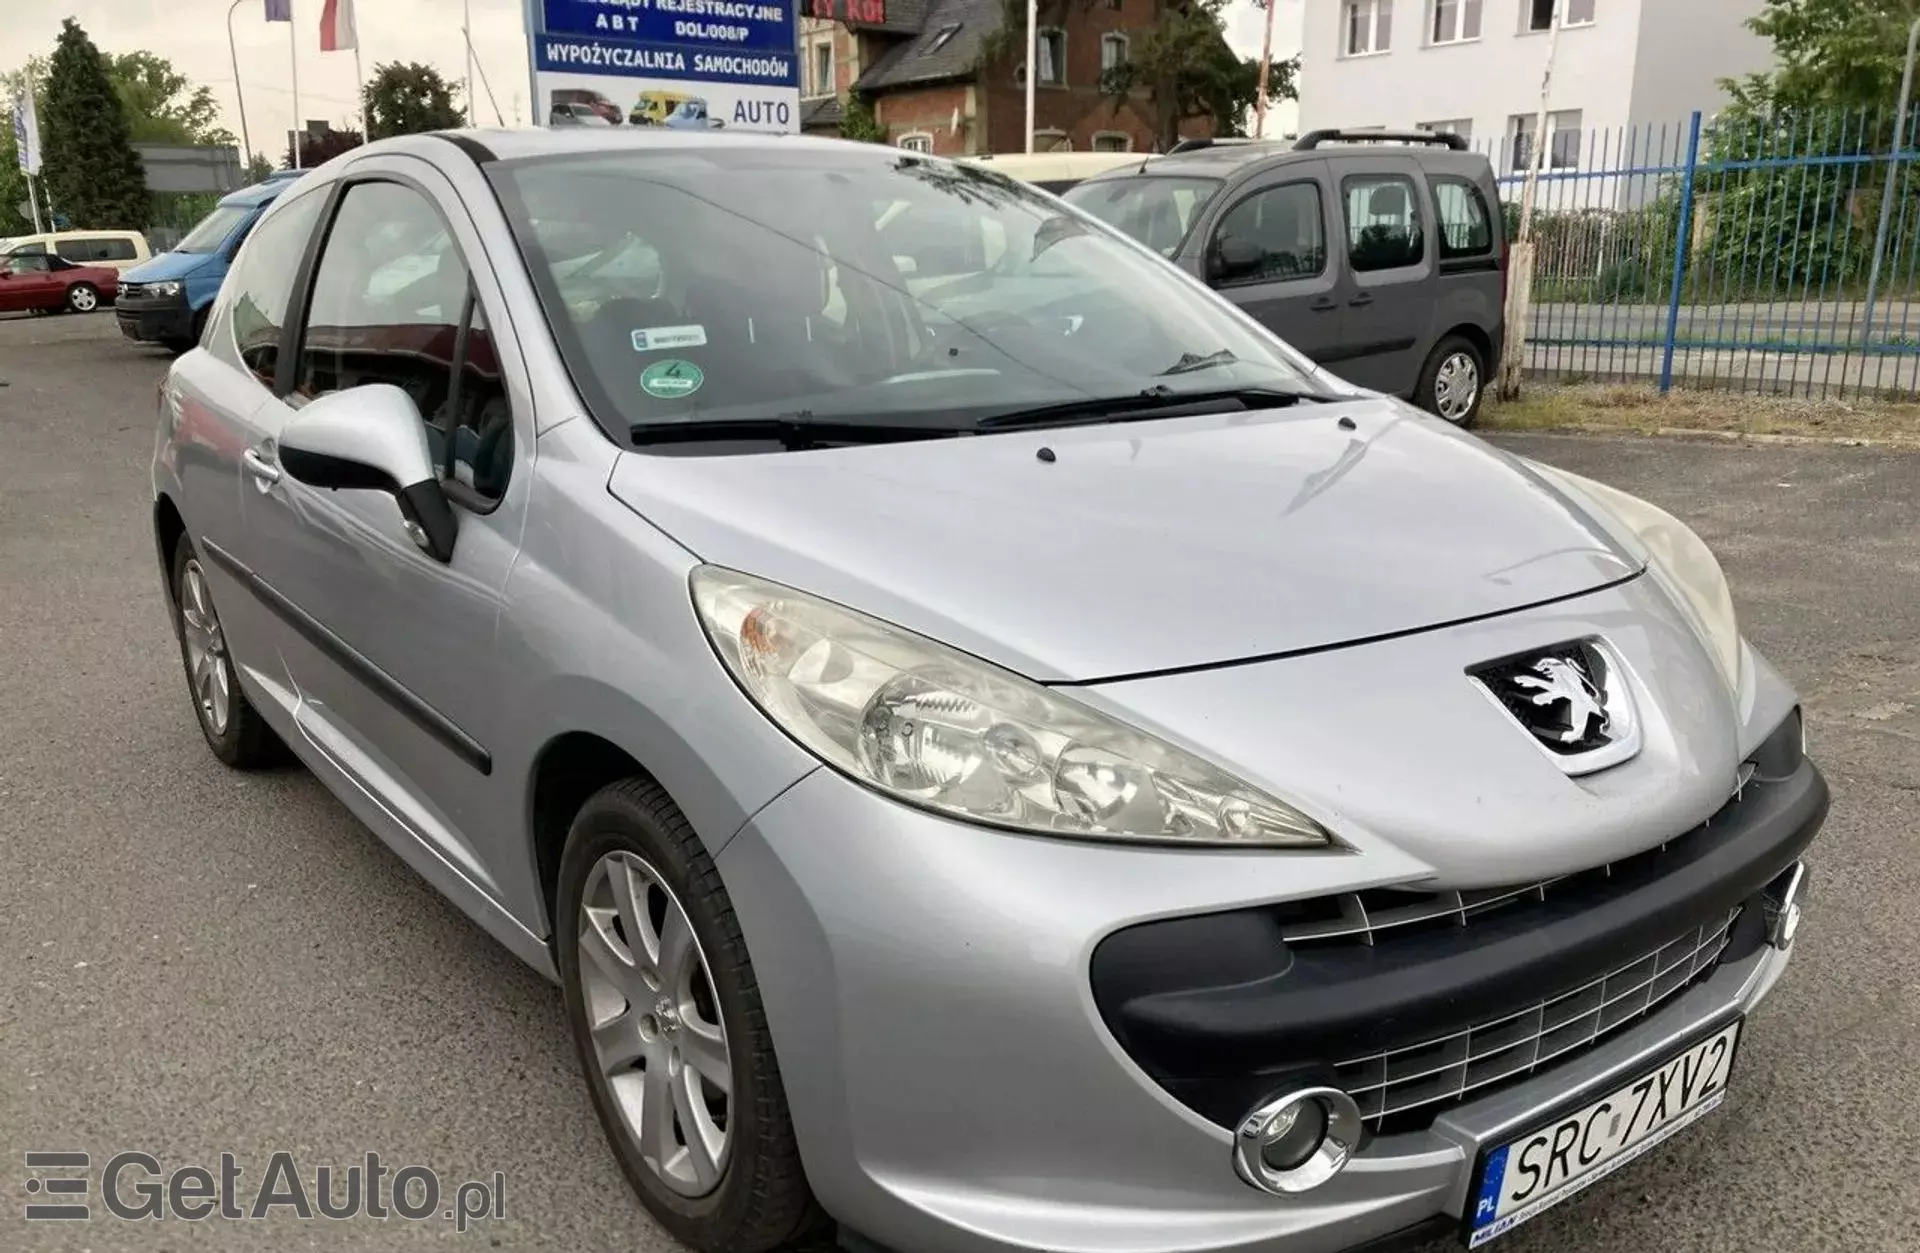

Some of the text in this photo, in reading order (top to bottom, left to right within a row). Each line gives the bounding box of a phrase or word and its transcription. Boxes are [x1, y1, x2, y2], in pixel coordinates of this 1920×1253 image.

[547, 43, 788, 77] WYPOŻYCZALNIA SAMOCHODÓW
[733, 101, 789, 125] AUTO
[1511, 1035, 1728, 1202] SRC 7XV2
[1476, 1195, 1496, 1218] PL
